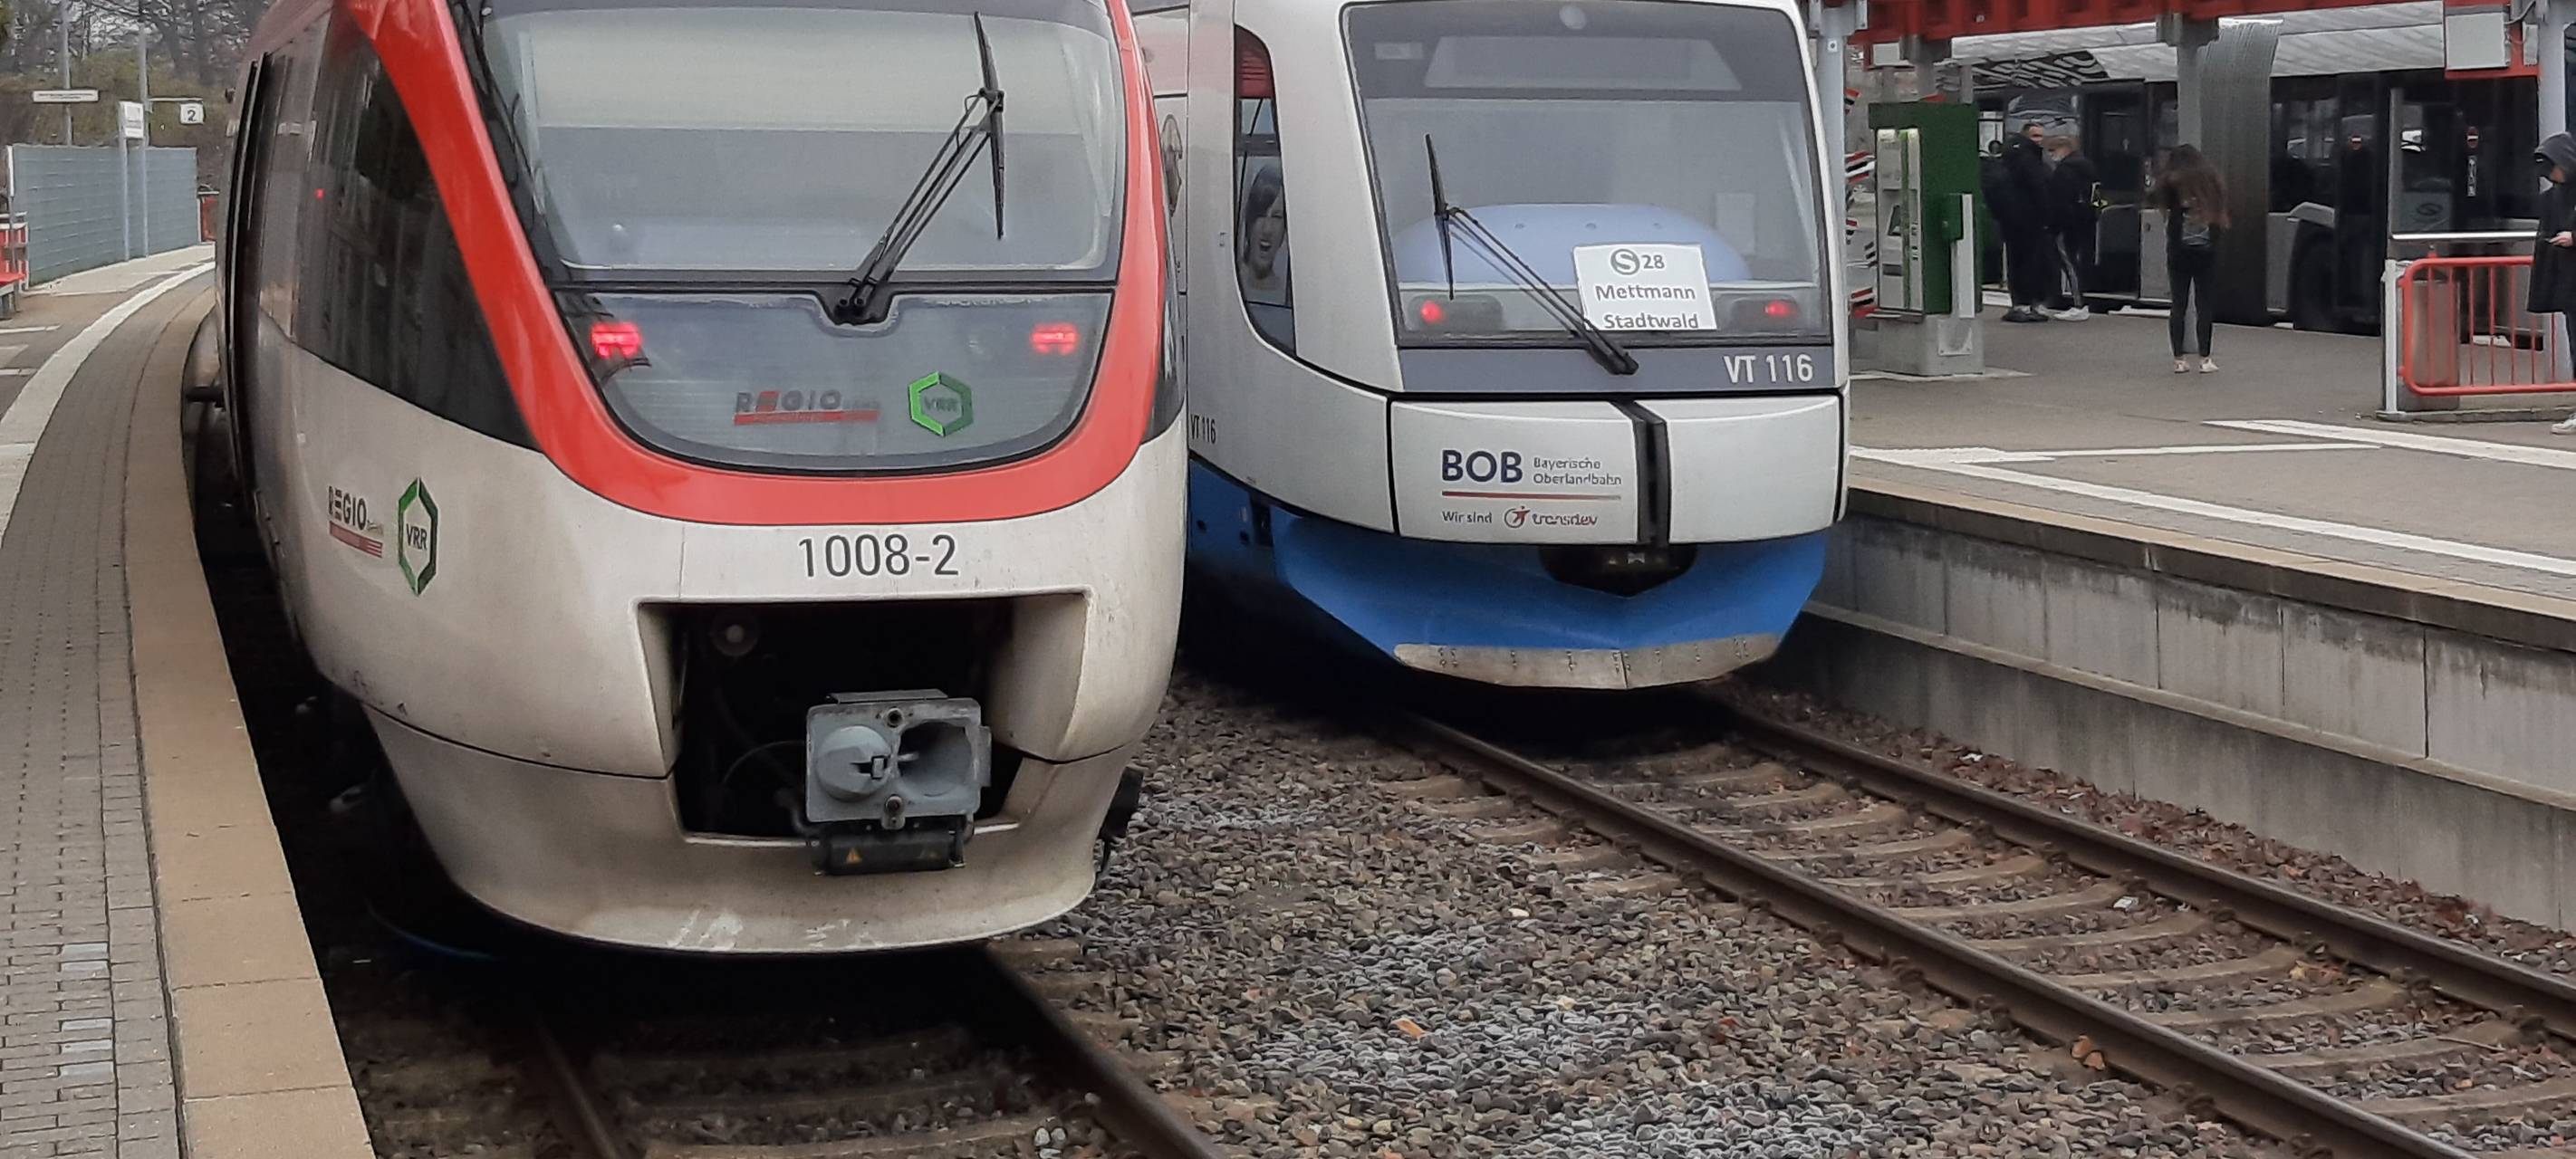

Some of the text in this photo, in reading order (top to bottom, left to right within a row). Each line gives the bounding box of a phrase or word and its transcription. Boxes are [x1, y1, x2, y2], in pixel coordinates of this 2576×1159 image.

[187, 109, 197, 121] 2
[1610, 249, 1665, 275] S 28
[1595, 285, 1697, 302] Mettmann
[1603, 313, 1698, 330] Stadtwald
[1725, 353, 1813, 384] VT 116
[1190, 414, 1216, 445] VT 116
[1442, 449, 1523, 483] BOB
[1533, 456, 1601, 471] Bayerische
[1533, 473, 1622, 485] Oberlandbahn
[1442, 511, 1492, 523] Wir sind
[406, 522, 428, 551] VRR
[799, 533, 959, 578] 1008-2
